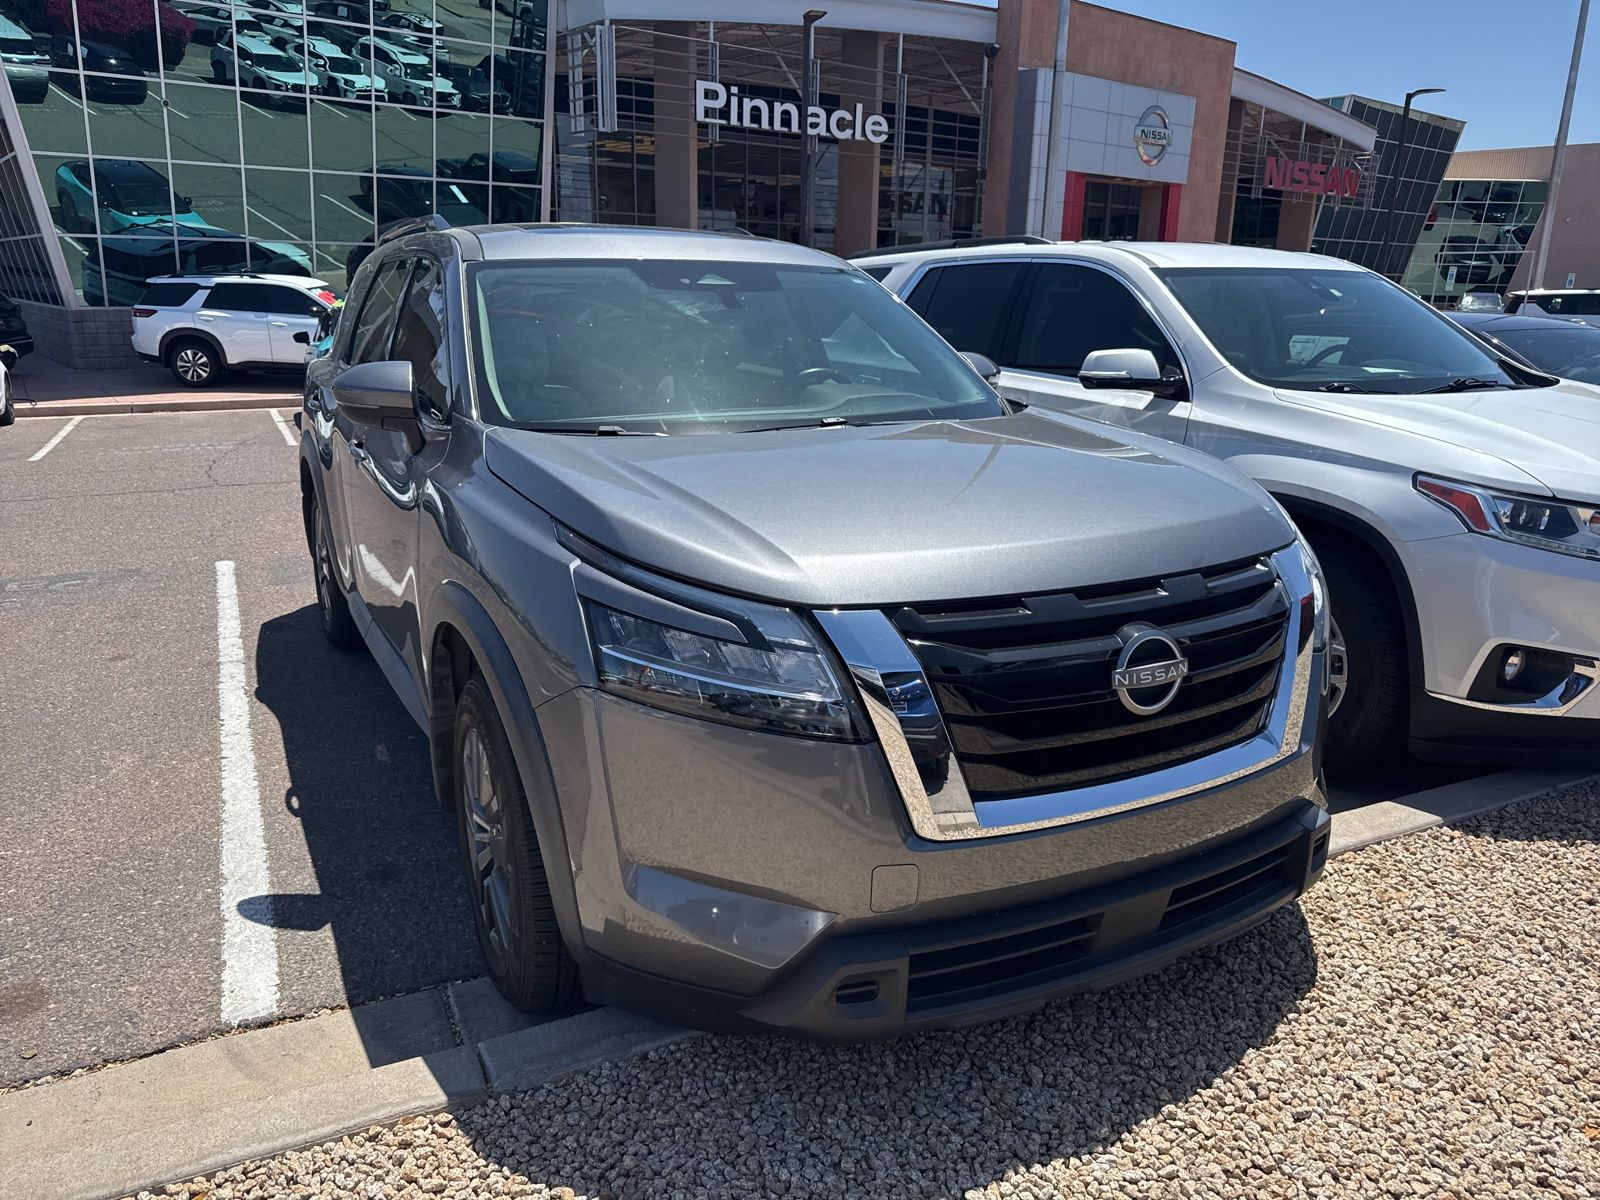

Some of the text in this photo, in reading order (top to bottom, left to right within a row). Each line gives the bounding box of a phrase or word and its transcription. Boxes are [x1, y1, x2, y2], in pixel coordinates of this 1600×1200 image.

[695, 80, 889, 144] Pinnacle
[1264, 156, 1361, 198] NISSAN
[1114, 661, 1187, 686] NISSAN
